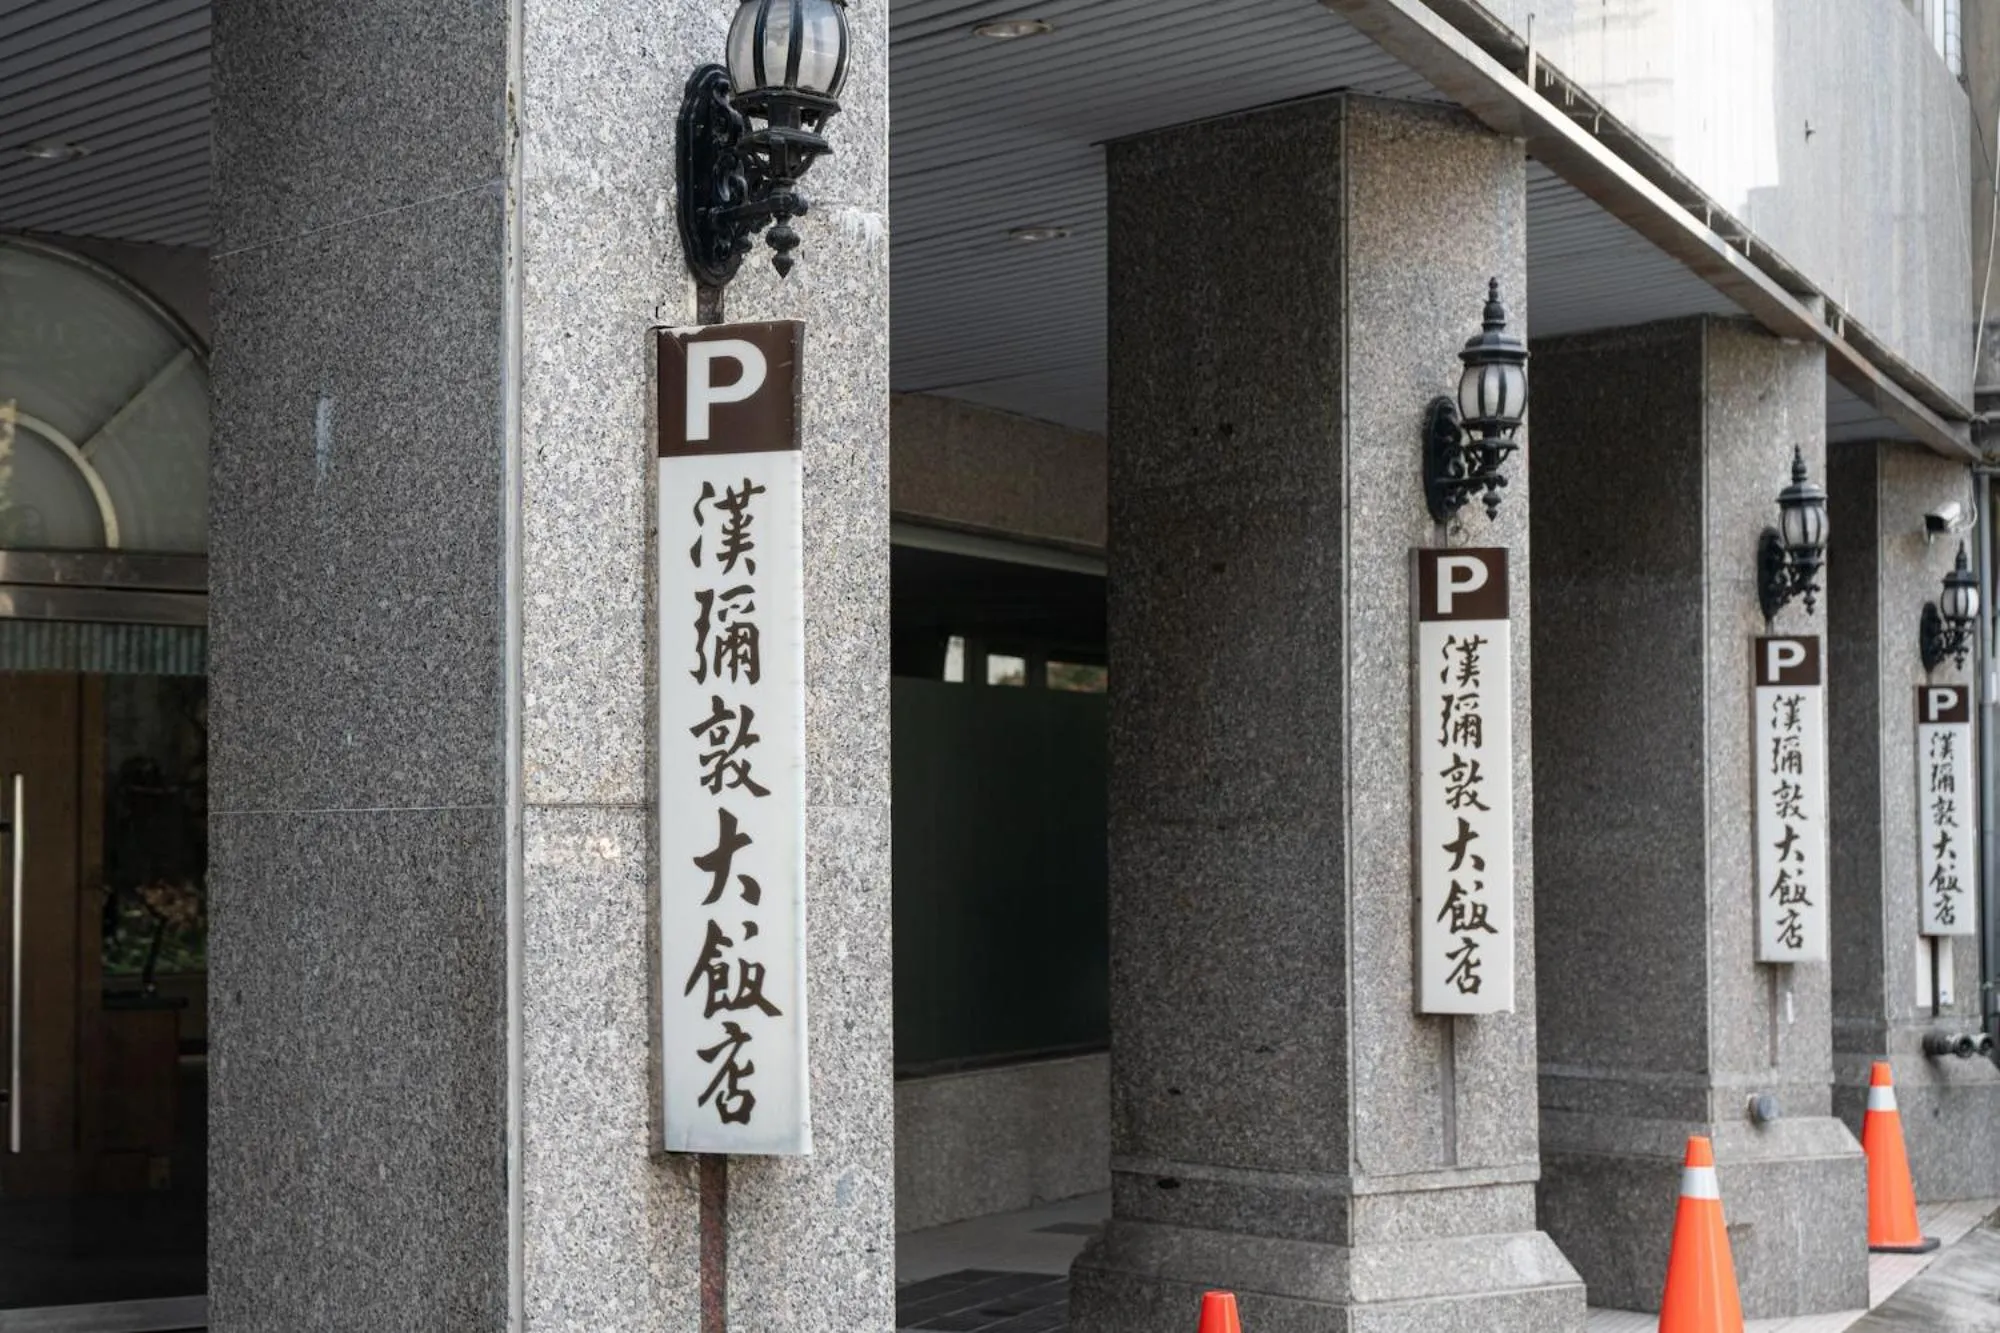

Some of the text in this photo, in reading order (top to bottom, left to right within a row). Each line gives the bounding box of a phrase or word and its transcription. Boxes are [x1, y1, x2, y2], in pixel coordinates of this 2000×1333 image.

[685, 339, 767, 441] P
[1437, 556, 1489, 614] P
[1767, 640, 1806, 682] P
[1928, 688, 1958, 720] P
[684, 478, 782, 1125] 漢彌敦大飯店
[1437, 634, 1498, 995] 漢彌敦大飯店
[1769, 694, 1814, 949] 漢彌敦大飯店
